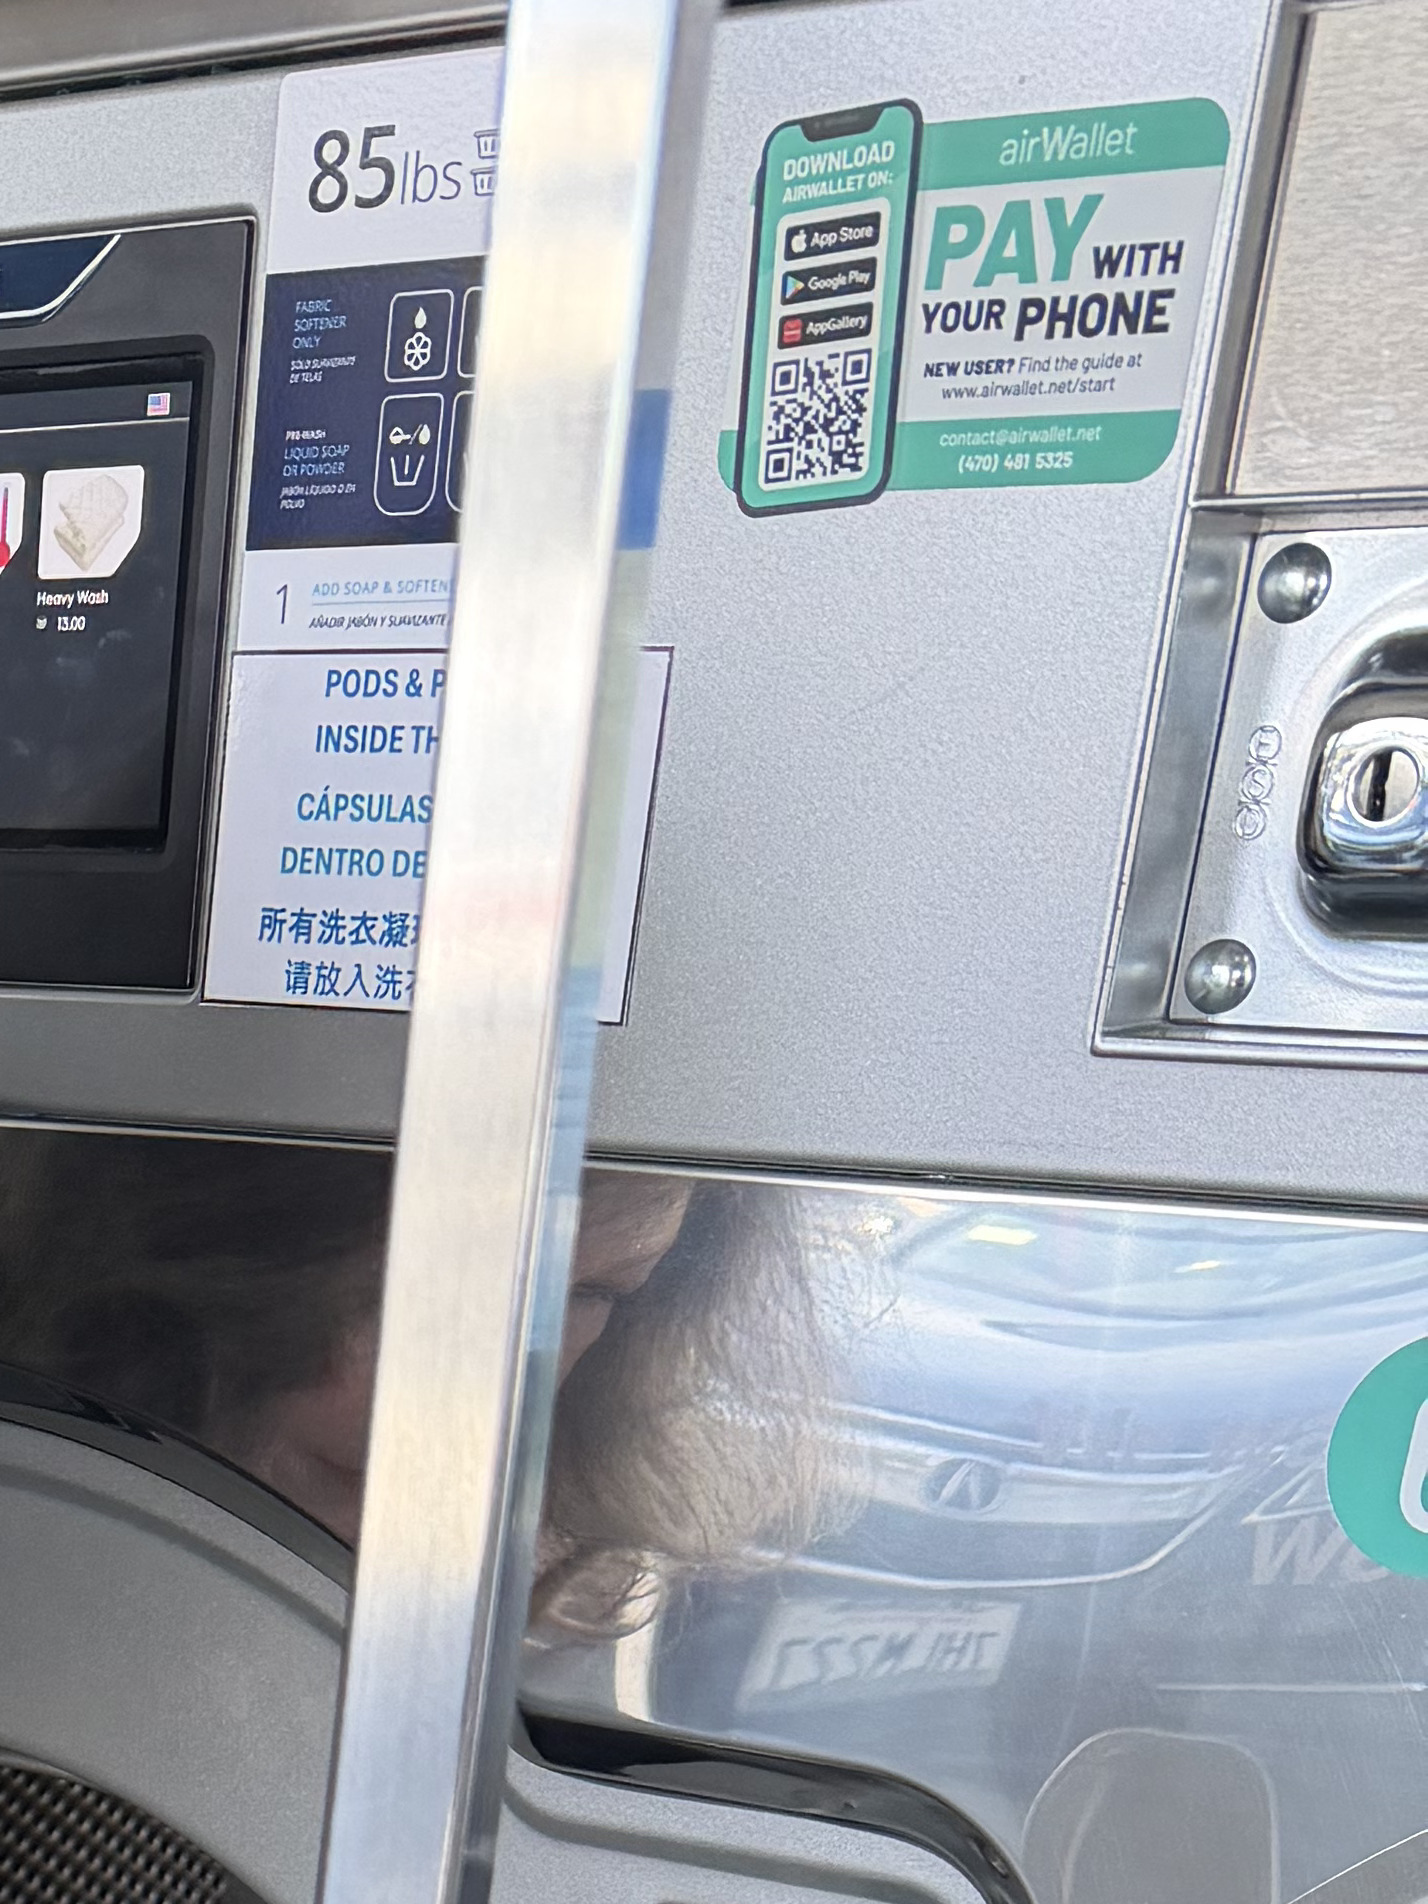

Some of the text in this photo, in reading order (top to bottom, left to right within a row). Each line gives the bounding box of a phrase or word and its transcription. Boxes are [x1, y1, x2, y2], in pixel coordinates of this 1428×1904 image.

[999, 122, 1138, 166] airWallet
[783, 141, 895, 181] DOWNLOAD
[782, 170, 894, 204] AIRWALLET ON:
[810, 224, 874, 248] App Store
[924, 193, 1184, 291] PAY WITH
[807, 269, 871, 291] Google Play
[296, 299, 332, 312] FABRIC
[921, 288, 1176, 341] YOUR PHONE
[293, 316, 347, 332] SOFTENER
[806, 315, 868, 337] AppGallery
[292, 336, 321, 350] ONLY
[923, 352, 1142, 378] NEW USER? Find the guide at
[941, 377, 1116, 399] www.airwallet.net/start
[939, 425, 1102, 447] contact@airwallet.net
[284, 444, 350, 462] LIQUID SOAP
[958, 452, 1073, 473] (470) 481 5325
[283, 462, 345, 477] OR POWDER
[36, 589, 109, 609] Heavy Wash
[276, 579, 448, 624] 1 ADD SOAP & SOFTEN
[57, 616, 86, 631] 13.00
[379, 616, 386, 627] Y
[324, 668, 446, 697] PODS & P
[315, 725, 439, 754] INSIDE TH
[297, 785, 433, 823] CÁPSULAS
[280, 847, 384, 876] DENTRO
